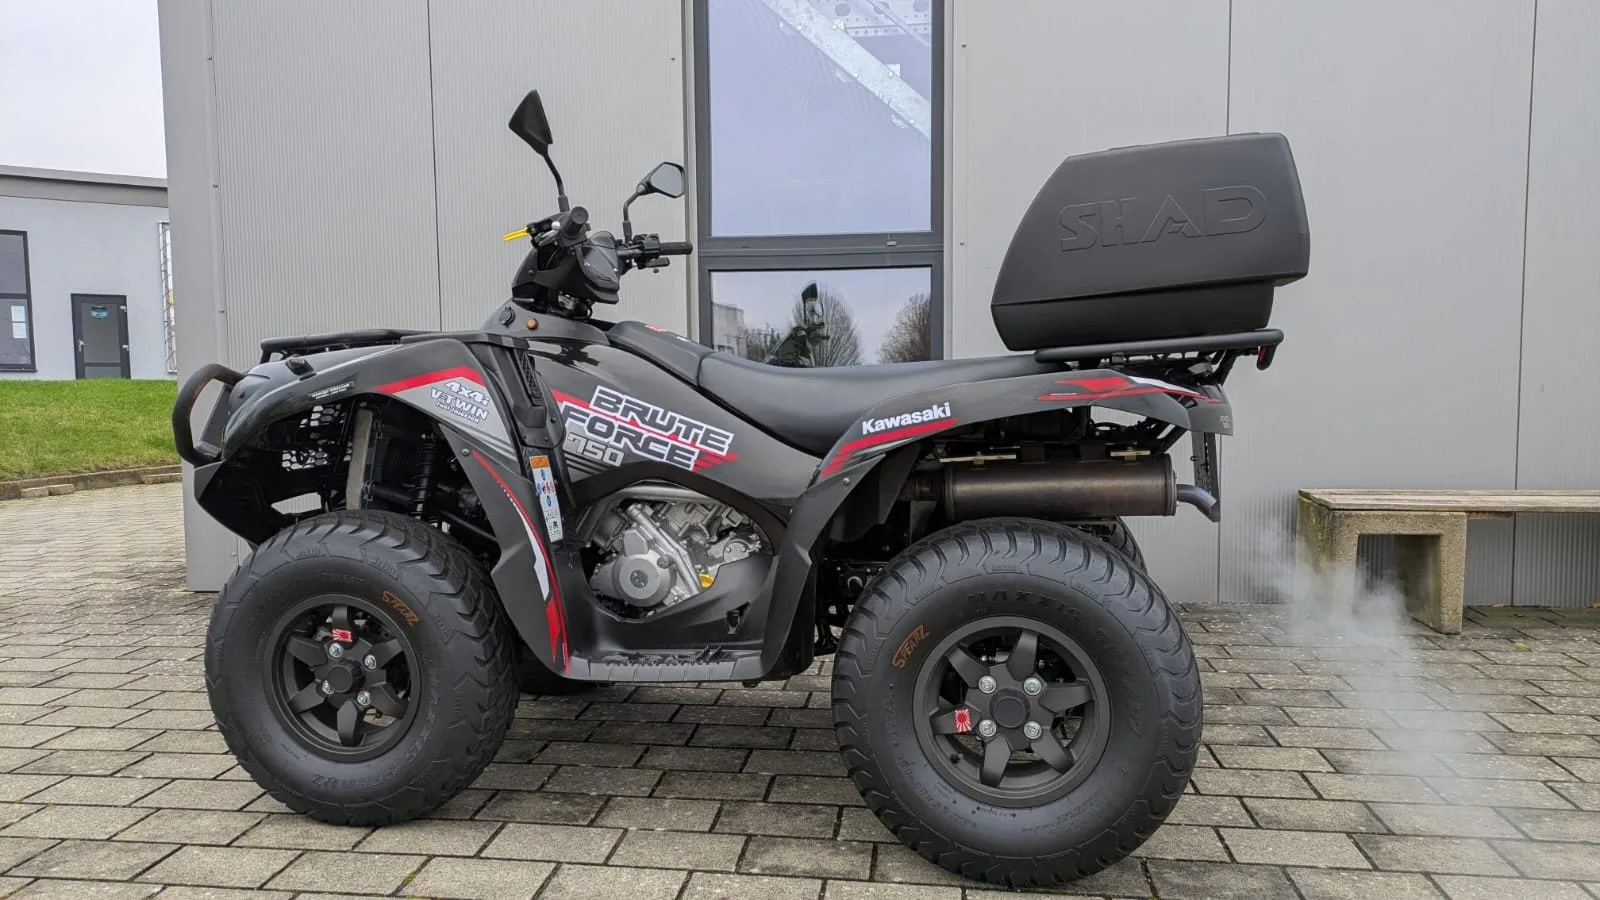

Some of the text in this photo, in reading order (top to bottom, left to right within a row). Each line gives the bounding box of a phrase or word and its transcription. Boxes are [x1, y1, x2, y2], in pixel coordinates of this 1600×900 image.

[1058, 184, 1267, 252] SHAD
[431, 388, 489, 420] V-TWIN
[588, 385, 734, 456] BRUTE
[862, 402, 952, 435] Kawasaki
[560, 401, 700, 471] FORCE
[566, 432, 625, 467] 750
[891, 624, 930, 669] SPEARZ
